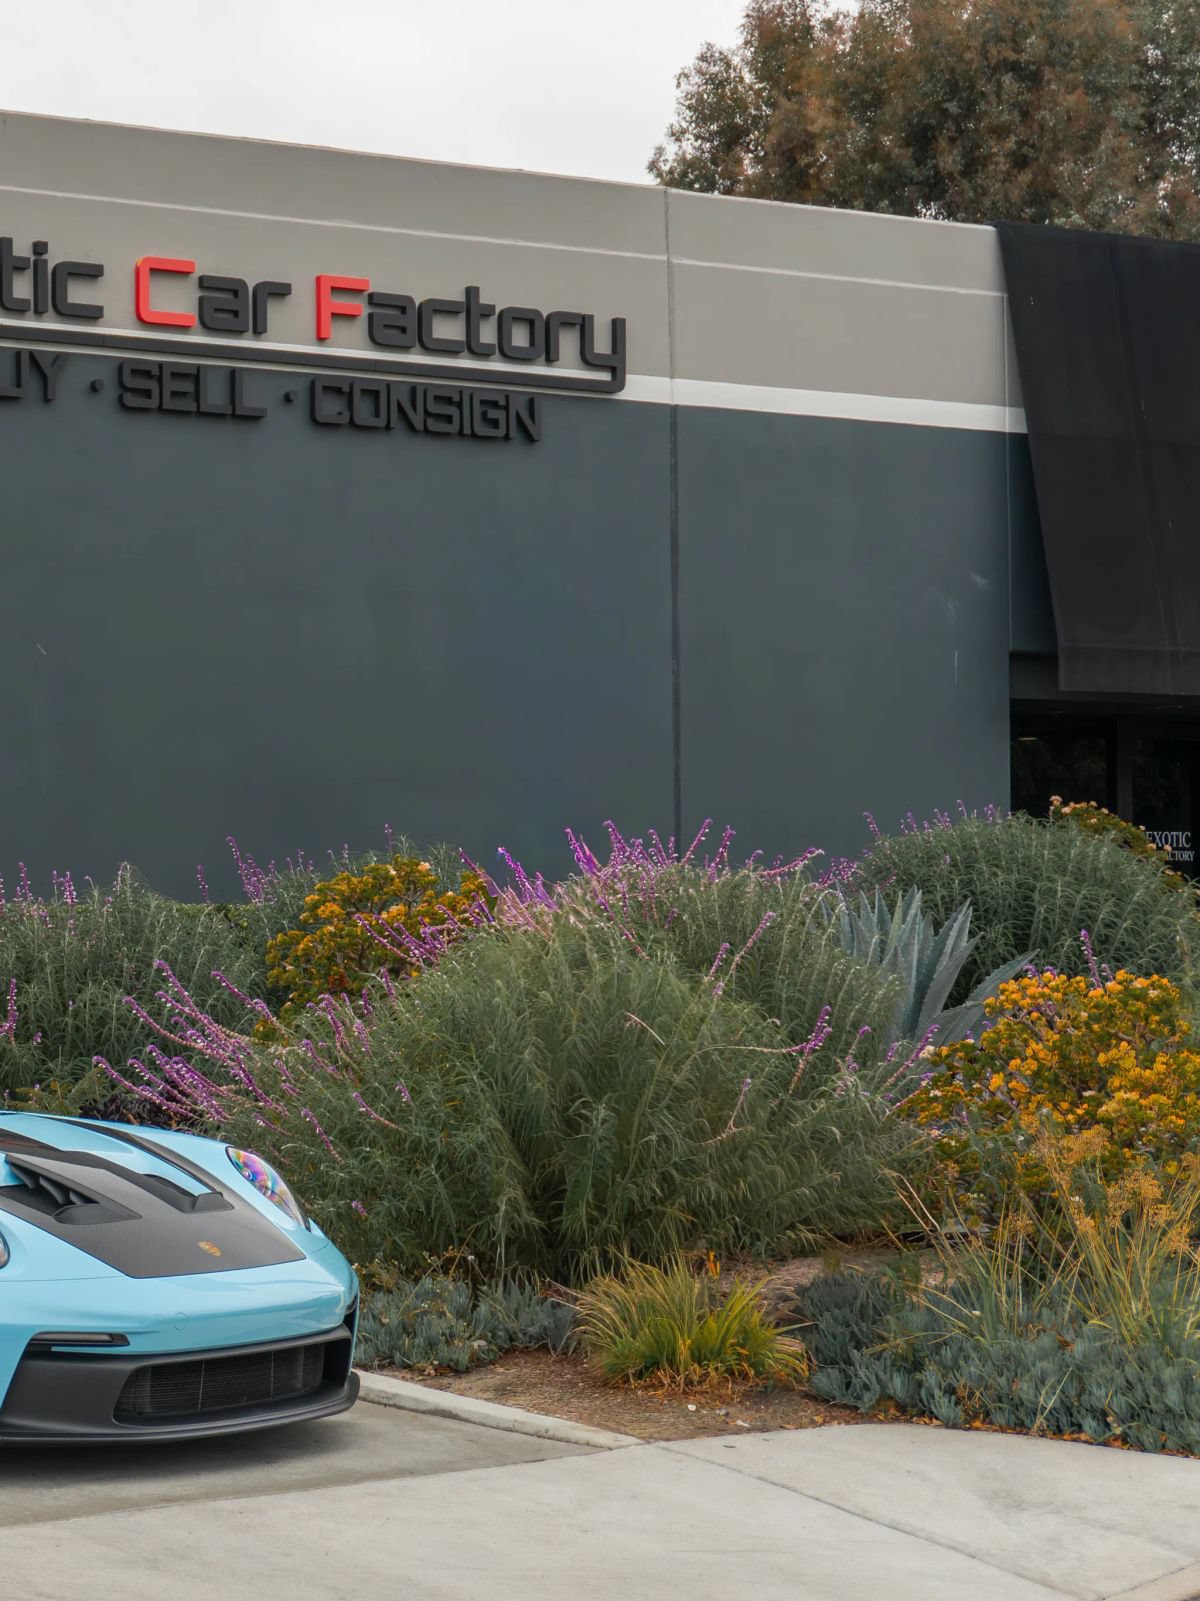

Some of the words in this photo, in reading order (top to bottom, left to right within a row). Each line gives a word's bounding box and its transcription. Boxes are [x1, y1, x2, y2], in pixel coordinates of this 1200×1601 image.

[135, 255, 293, 335] Car
[315, 274, 627, 394] Factory
[118, 360, 268, 418] SELL
[310, 376, 543, 442] CONSIGN
